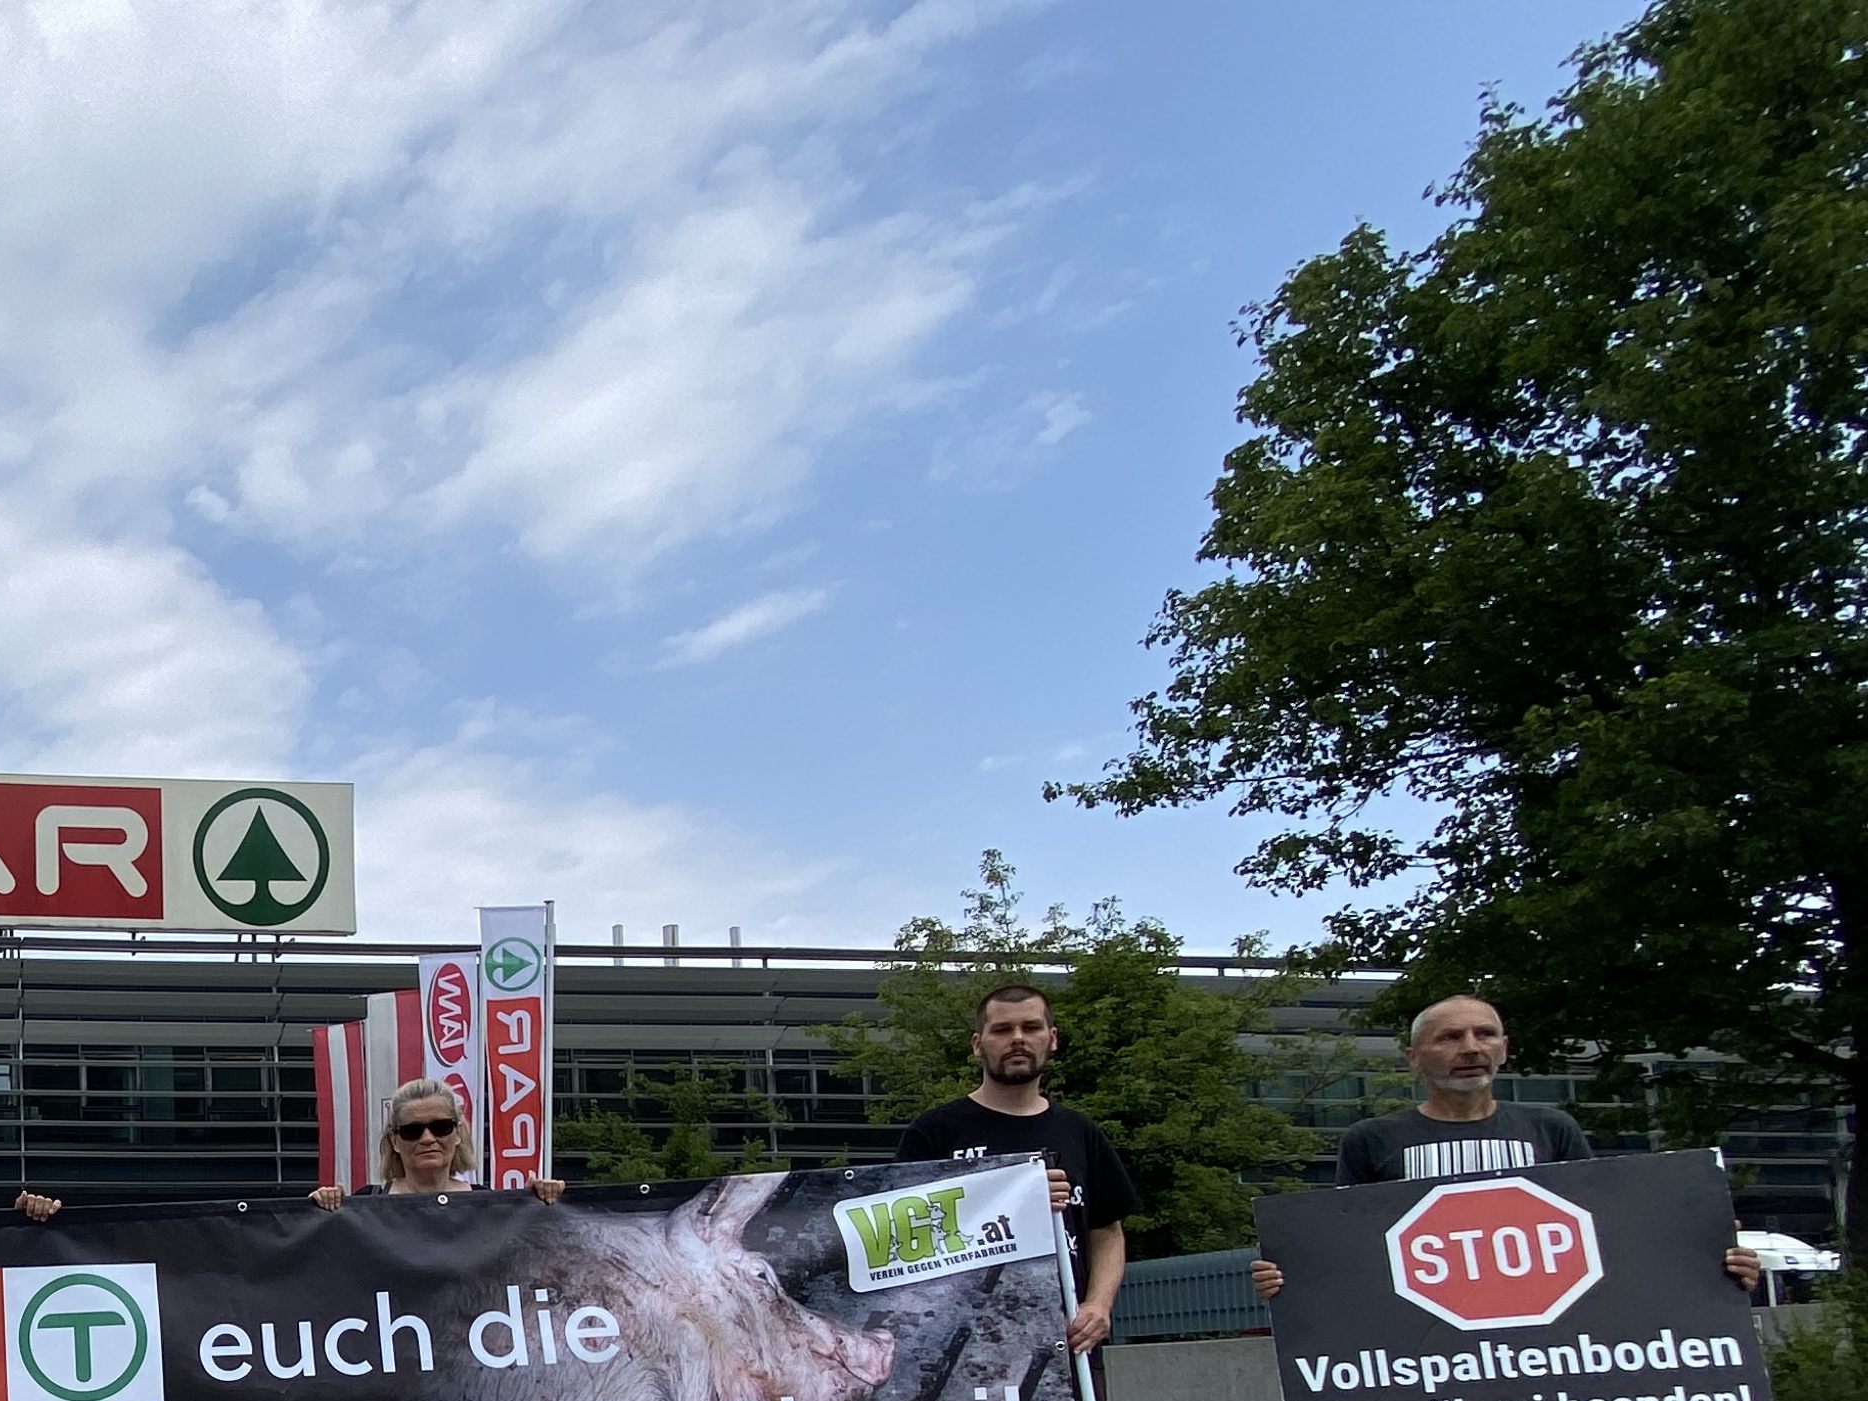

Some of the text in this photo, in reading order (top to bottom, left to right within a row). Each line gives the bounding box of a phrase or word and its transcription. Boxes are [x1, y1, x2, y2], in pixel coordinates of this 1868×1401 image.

[869, 1243, 1017, 1281] VEREIN GEGEN TIERFABRIKEN
[1410, 1222, 1575, 1286] STOP
[199, 1290, 434, 1383] euch
[469, 1284, 622, 1370] die
[1296, 1328, 1743, 1394] Vollspaltenboden
